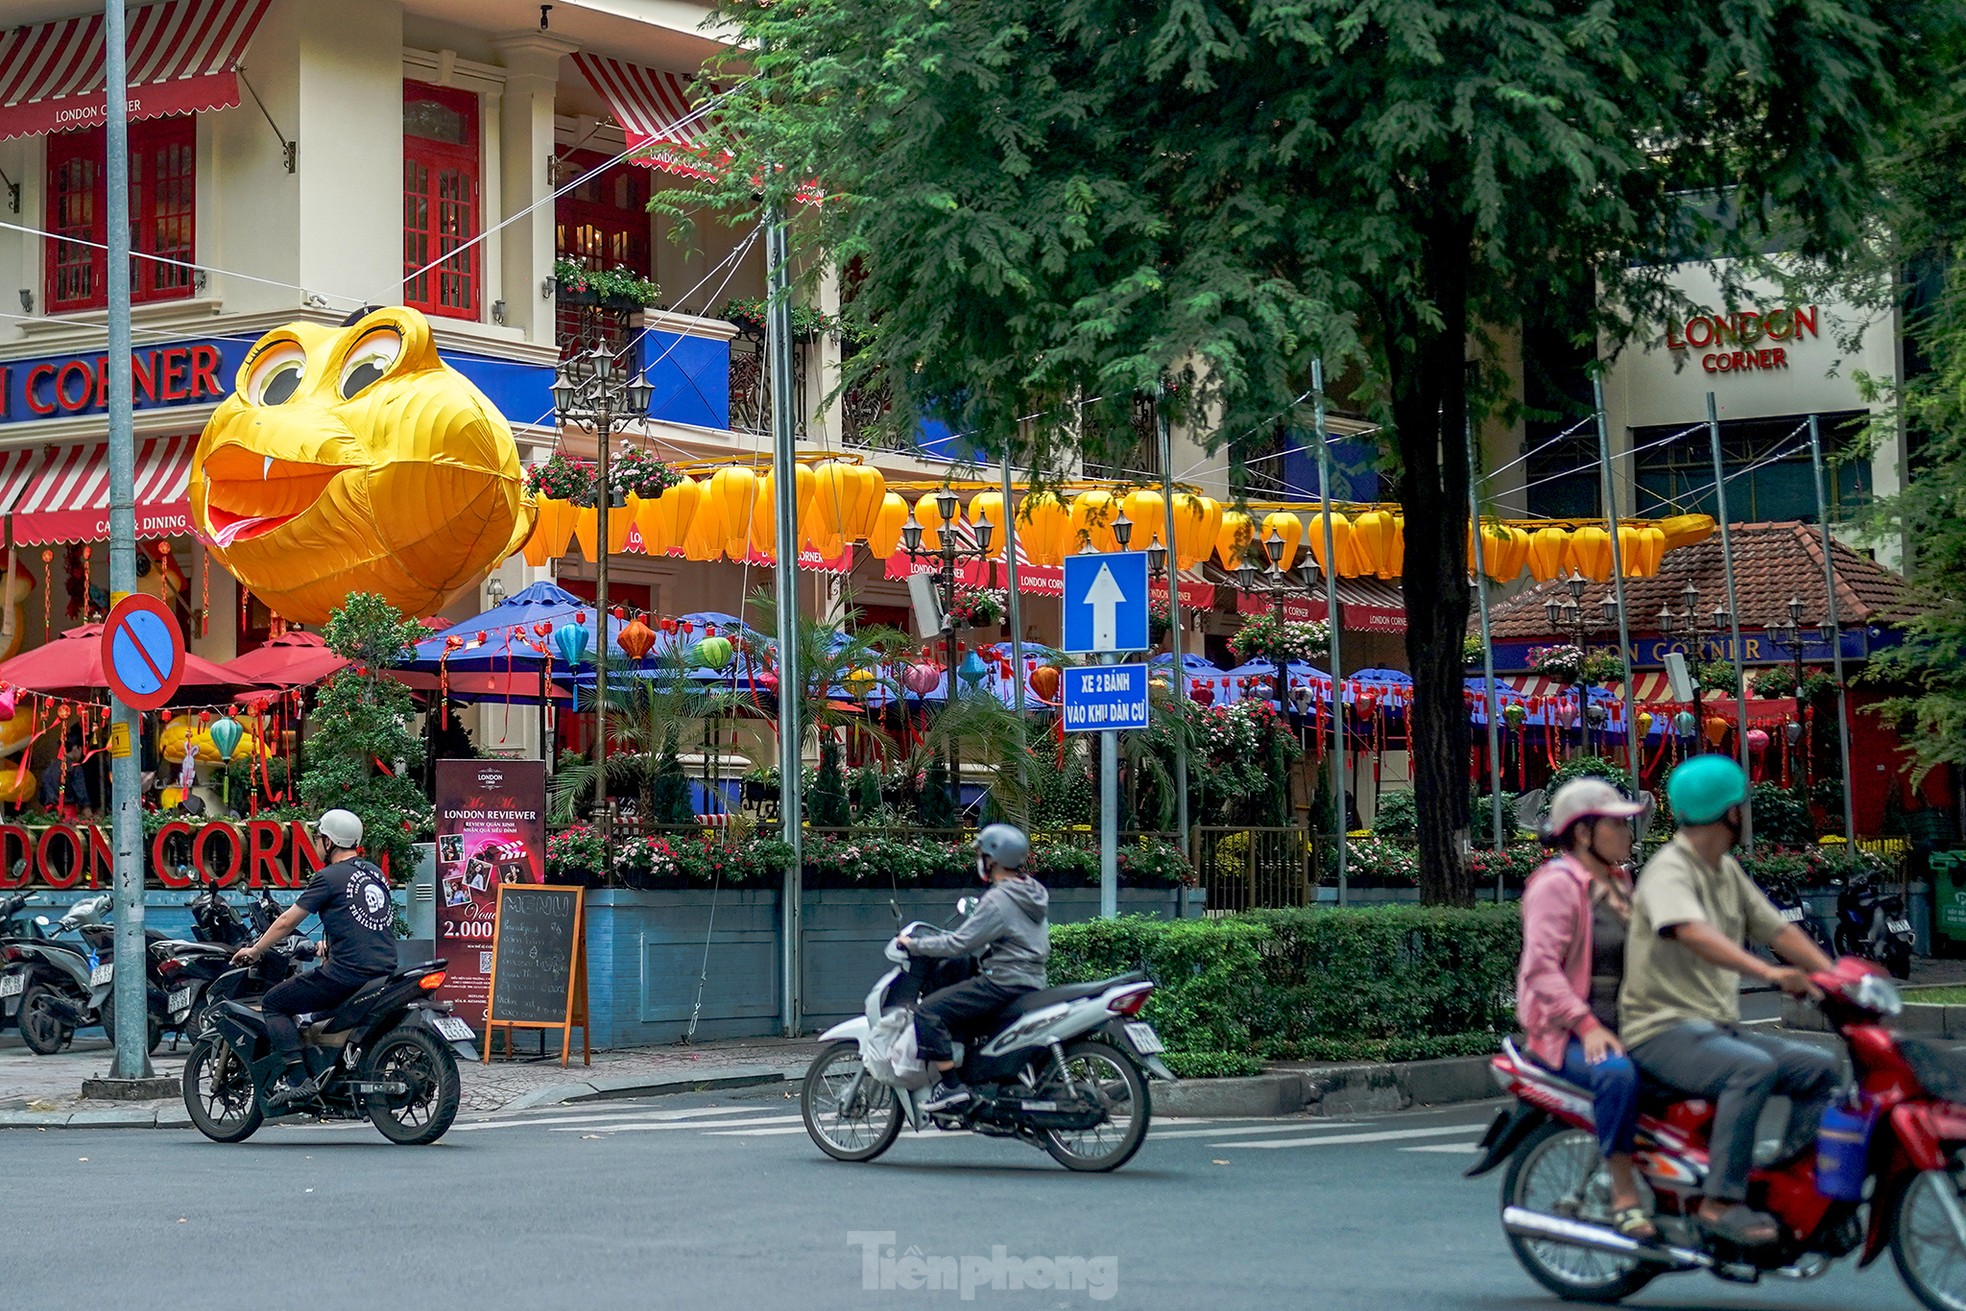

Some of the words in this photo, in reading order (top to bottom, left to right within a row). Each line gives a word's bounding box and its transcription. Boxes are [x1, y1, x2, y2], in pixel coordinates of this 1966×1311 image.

[56, 105, 97, 123] LONDON
[1667, 305, 1818, 349] LONDON
[1702, 348, 1787, 373] CORNER
[143, 515, 186, 530] DINING
[1021, 576, 1047, 588] LONDON
[1369, 615, 1390, 625] LONDON
[1391, 617, 1409, 627] CORNE
[1082, 674, 1094, 693] XE
[1096, 674, 1103, 692] 2
[1104, 669, 1130, 692] BÁNH
[1067, 701, 1086, 723] VÀO
[1088, 704, 1108, 722] KHU
[1131, 699, 1145, 721] CƯ
[444, 810, 485, 819] LONDON
[487, 811, 536, 820] REVIEWER
[153, 820, 326, 889] CORN
[503, 895, 569, 917] MENU
